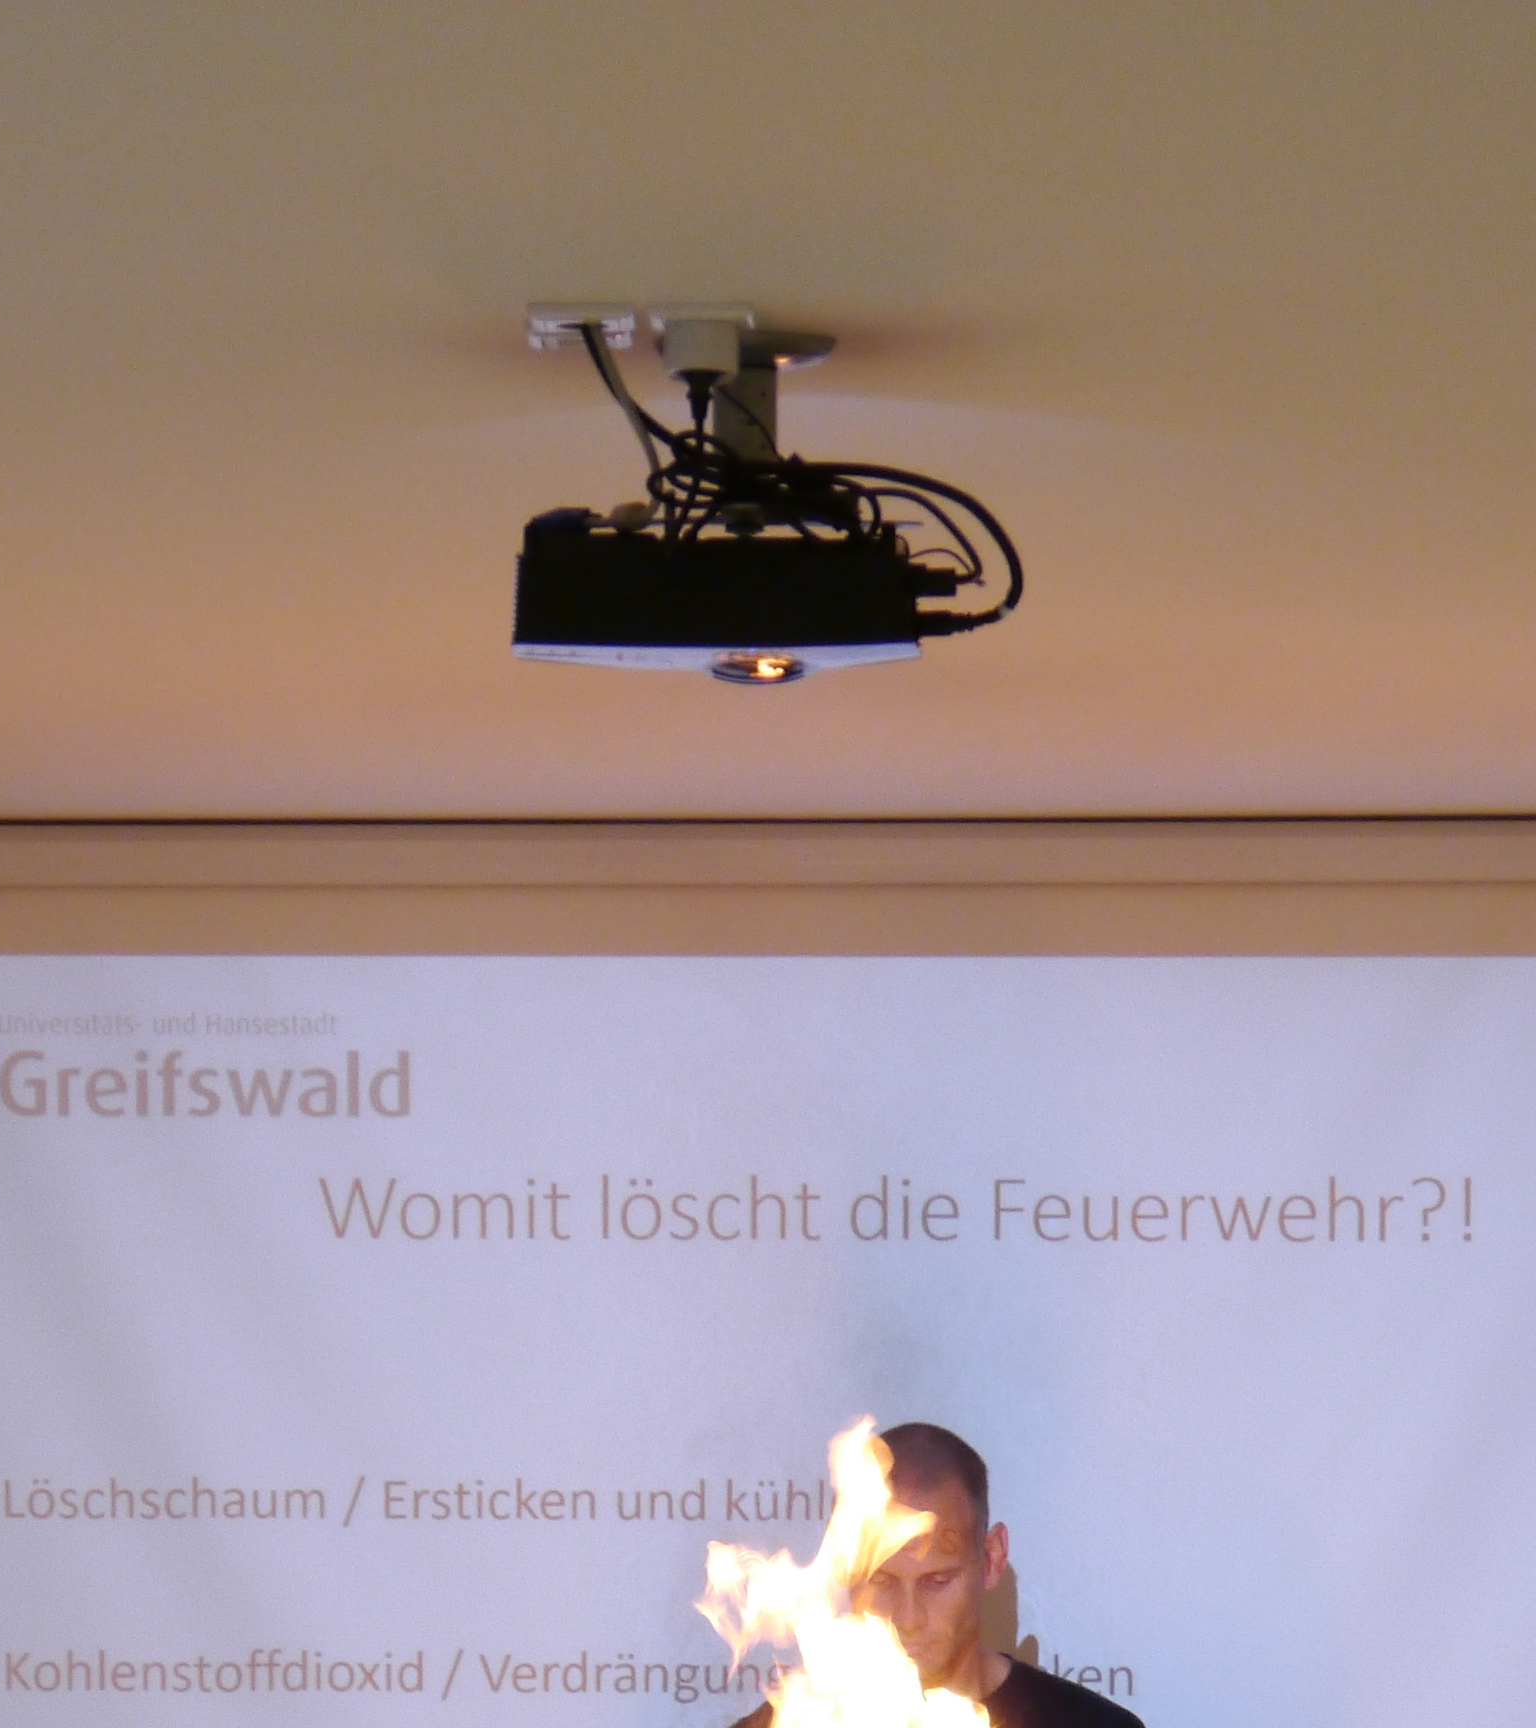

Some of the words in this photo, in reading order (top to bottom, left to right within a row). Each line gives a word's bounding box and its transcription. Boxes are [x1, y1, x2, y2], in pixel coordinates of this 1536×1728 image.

[152, 1011, 197, 1037] und
[205, 1011, 340, 1038] Hansestadt
[318, 1176, 572, 1242] Womit
[600, 1173, 822, 1243] löscht
[849, 1173, 961, 1243] die
[992, 1174, 1473, 1244] Feuerwehr?!
[3, 1475, 327, 1522] Löschschaum
[382, 1476, 598, 1522] Ersticken
[615, 1477, 708, 1522] und
[724, 1477, 836, 1524] kühl
[4, 1647, 425, 1695] Kohlenstoffdioxid
